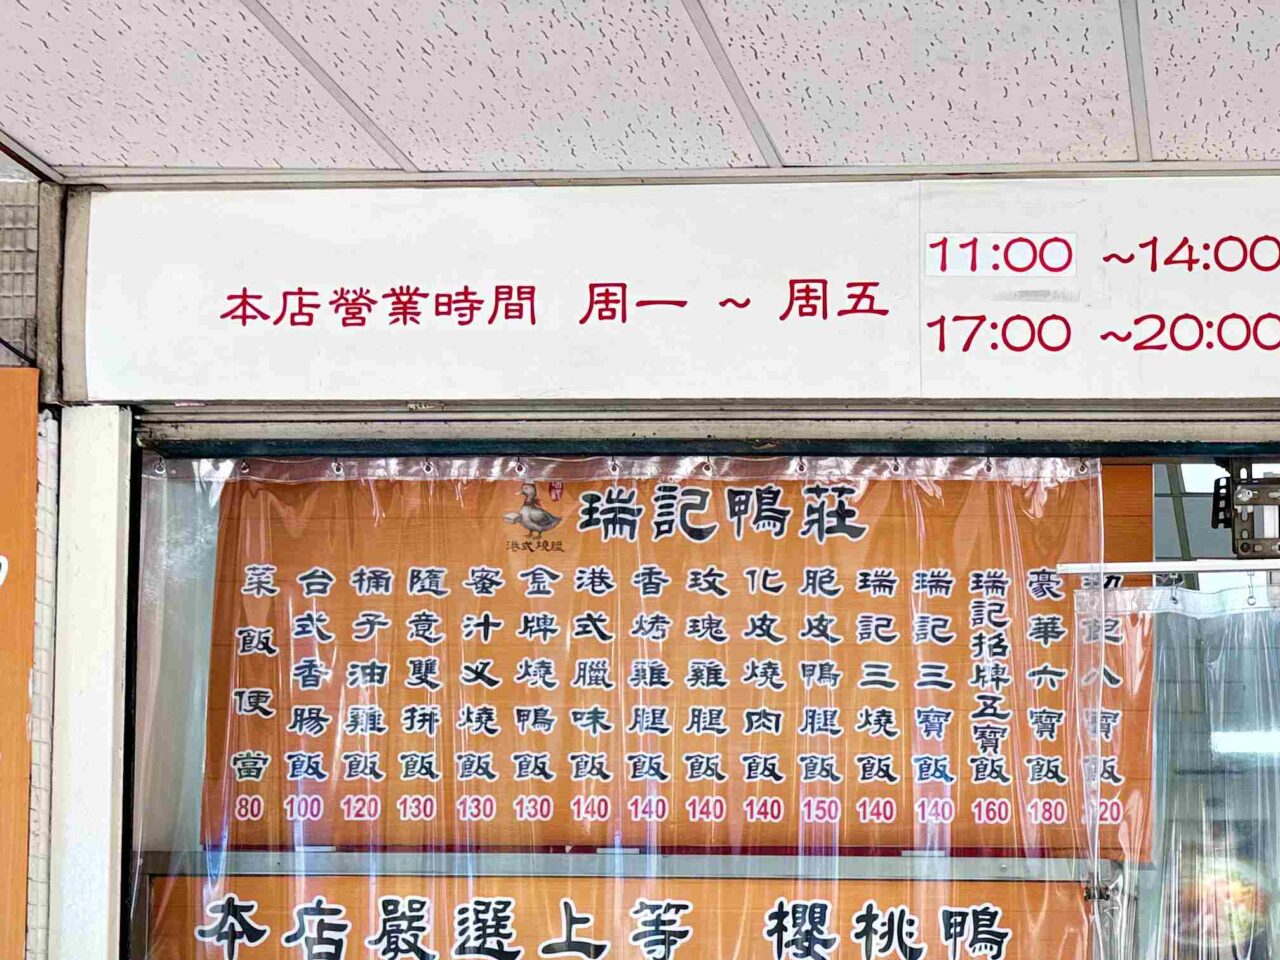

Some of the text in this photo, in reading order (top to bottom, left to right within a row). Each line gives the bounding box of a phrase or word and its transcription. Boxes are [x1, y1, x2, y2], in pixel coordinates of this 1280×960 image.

[218, 284, 538, 328] 本店營業時間
[578, 281, 689, 327] 周一
[778, 277, 890, 322] 周五
[926, 313, 1072, 354] 17:00
[929, 236, 1074, 274] 11:00
[578, 483, 868, 544] 瑞記鴨莊
[230, 565, 280, 820] 菜飯便當 80
[284, 567, 335, 821] 台式香腸飯 100
[341, 566, 393, 821] 桶子油雞飯 120
[398, 567, 451, 821] 隨意雙拼飯 130
[455, 566, 505, 821] 蜜汁叉燒飯 130
[511, 566, 561, 821] 金牌燒鴨飯 130
[569, 566, 617, 821] 港式臘味飯 140
[626, 564, 672, 821] 香烤雞腿飯 140
[684, 564, 729, 821] 玫瑰雞腿飯 140
[741, 567, 786, 821] 化皮燒肉飯 140
[801, 797, 840, 822] 150
[855, 568, 899, 822] 瑞記三燒飯 140
[911, 567, 956, 823] 瑞記三寶飯 140
[968, 568, 1012, 824] 瑞記招牌五寶飯 160
[1025, 568, 1069, 824] 豪華六寶飯 180
[1083, 799, 1123, 824] 20
